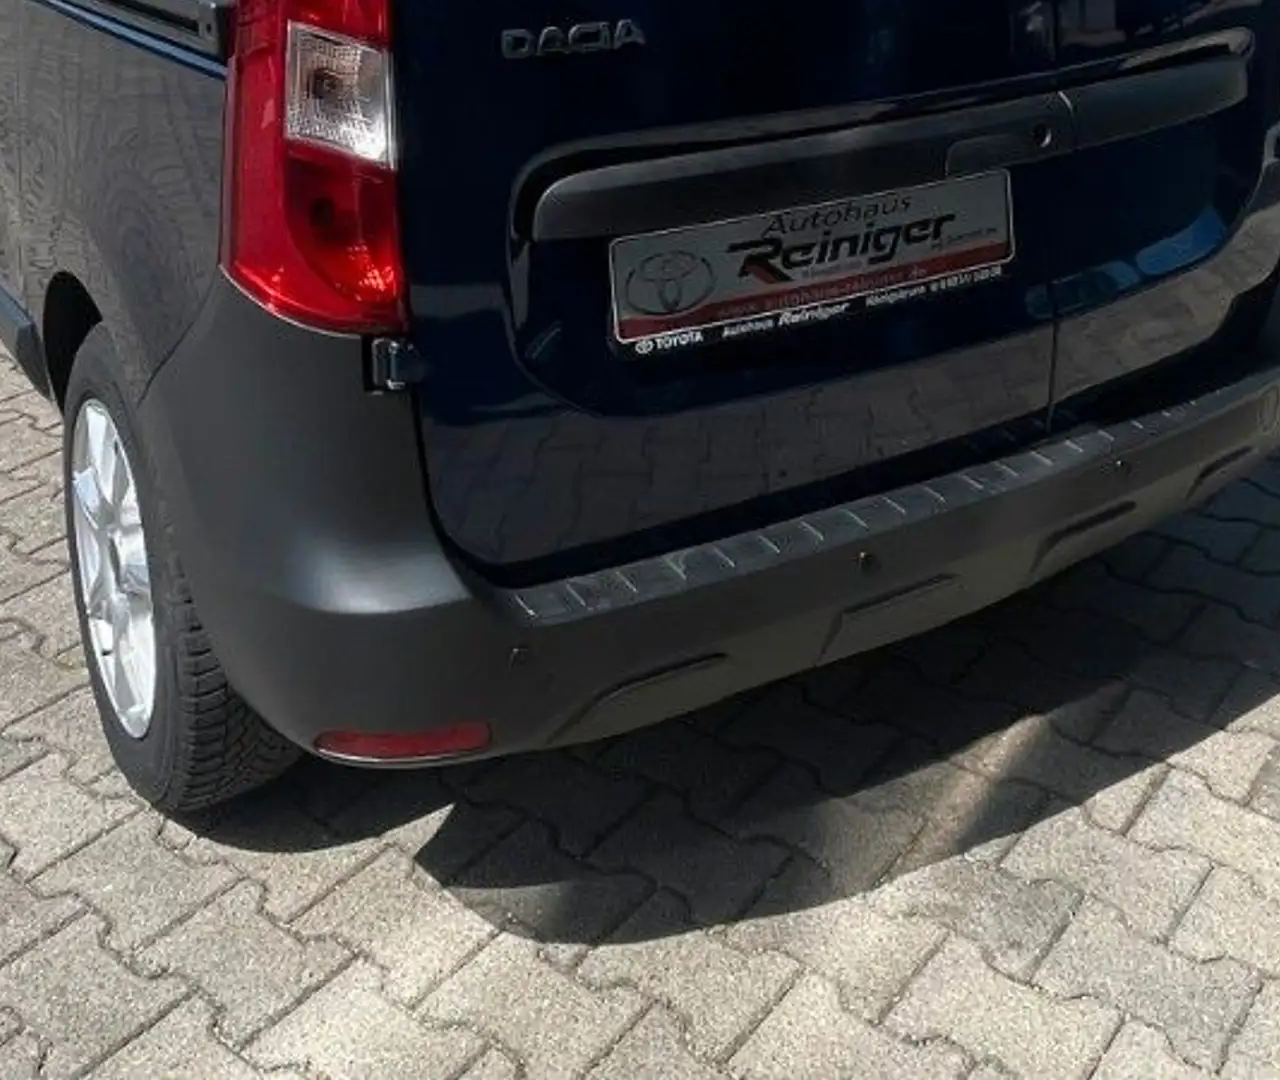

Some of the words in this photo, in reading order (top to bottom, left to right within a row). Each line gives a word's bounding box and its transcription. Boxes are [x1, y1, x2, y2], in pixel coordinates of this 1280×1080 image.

[501, 18, 645, 60] DACIA
[761, 195, 913, 239] Autohaus
[726, 213, 956, 282] Reiniger
[655, 332, 703, 350] TOYOTA
